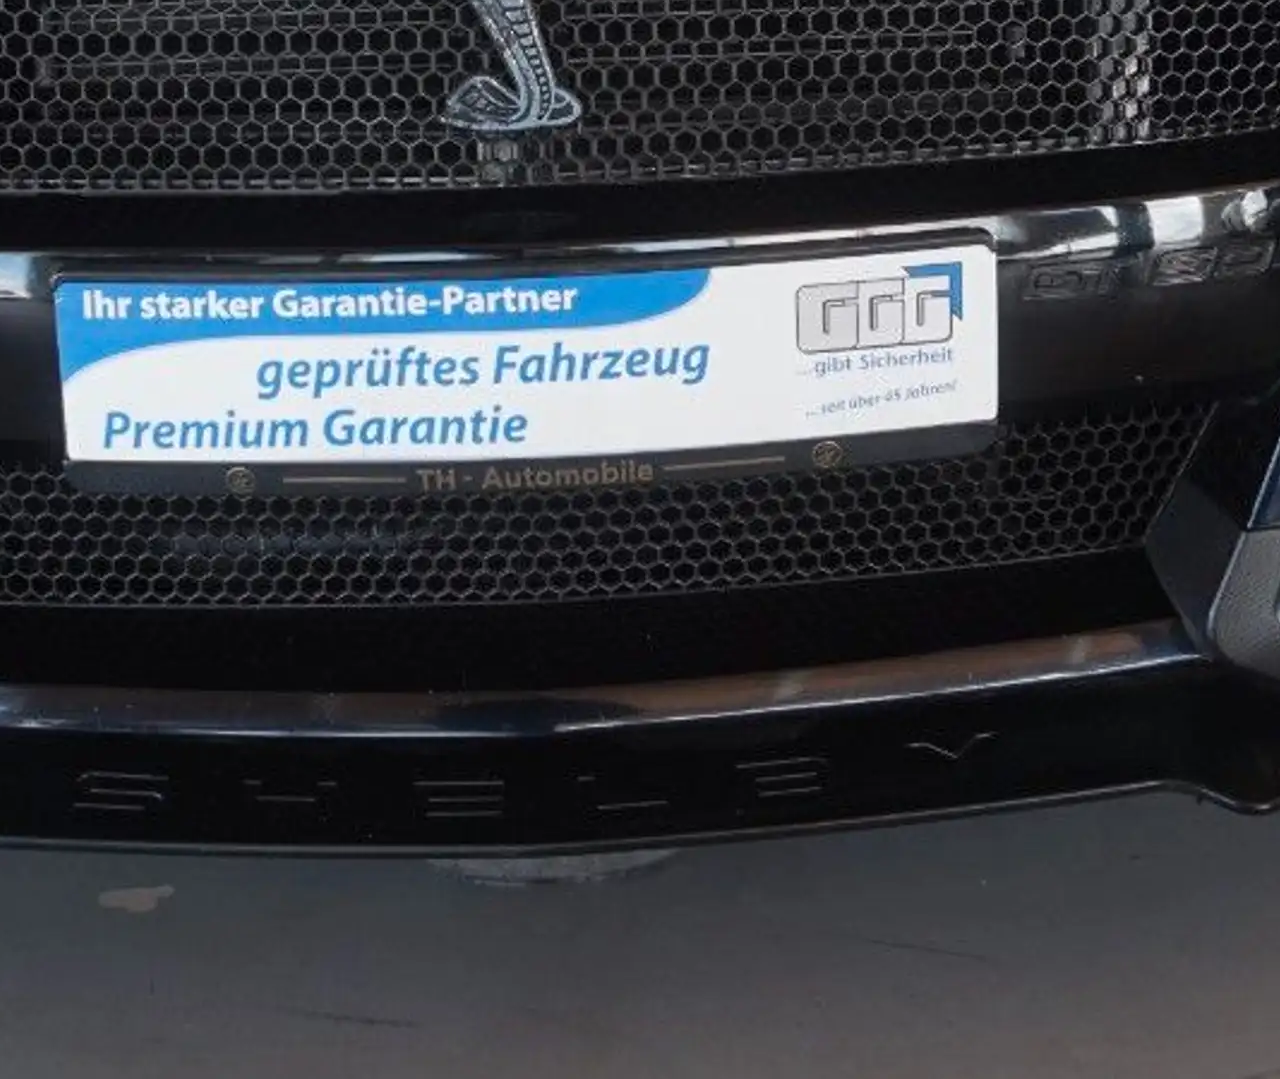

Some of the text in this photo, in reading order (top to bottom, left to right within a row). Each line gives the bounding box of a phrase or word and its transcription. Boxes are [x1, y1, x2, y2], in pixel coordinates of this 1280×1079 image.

[82, 283, 578, 320] Ihr starker Garantie-Partner
[256, 341, 710, 400] geprüftes Fahrzeug
[858, 347, 954, 371] Sicherheit
[103, 404, 529, 450] Premium Garantie
[416, 469, 456, 491] TH
[480, 459, 655, 491] Automobile
[72, 731, 997, 818] SHELBY
